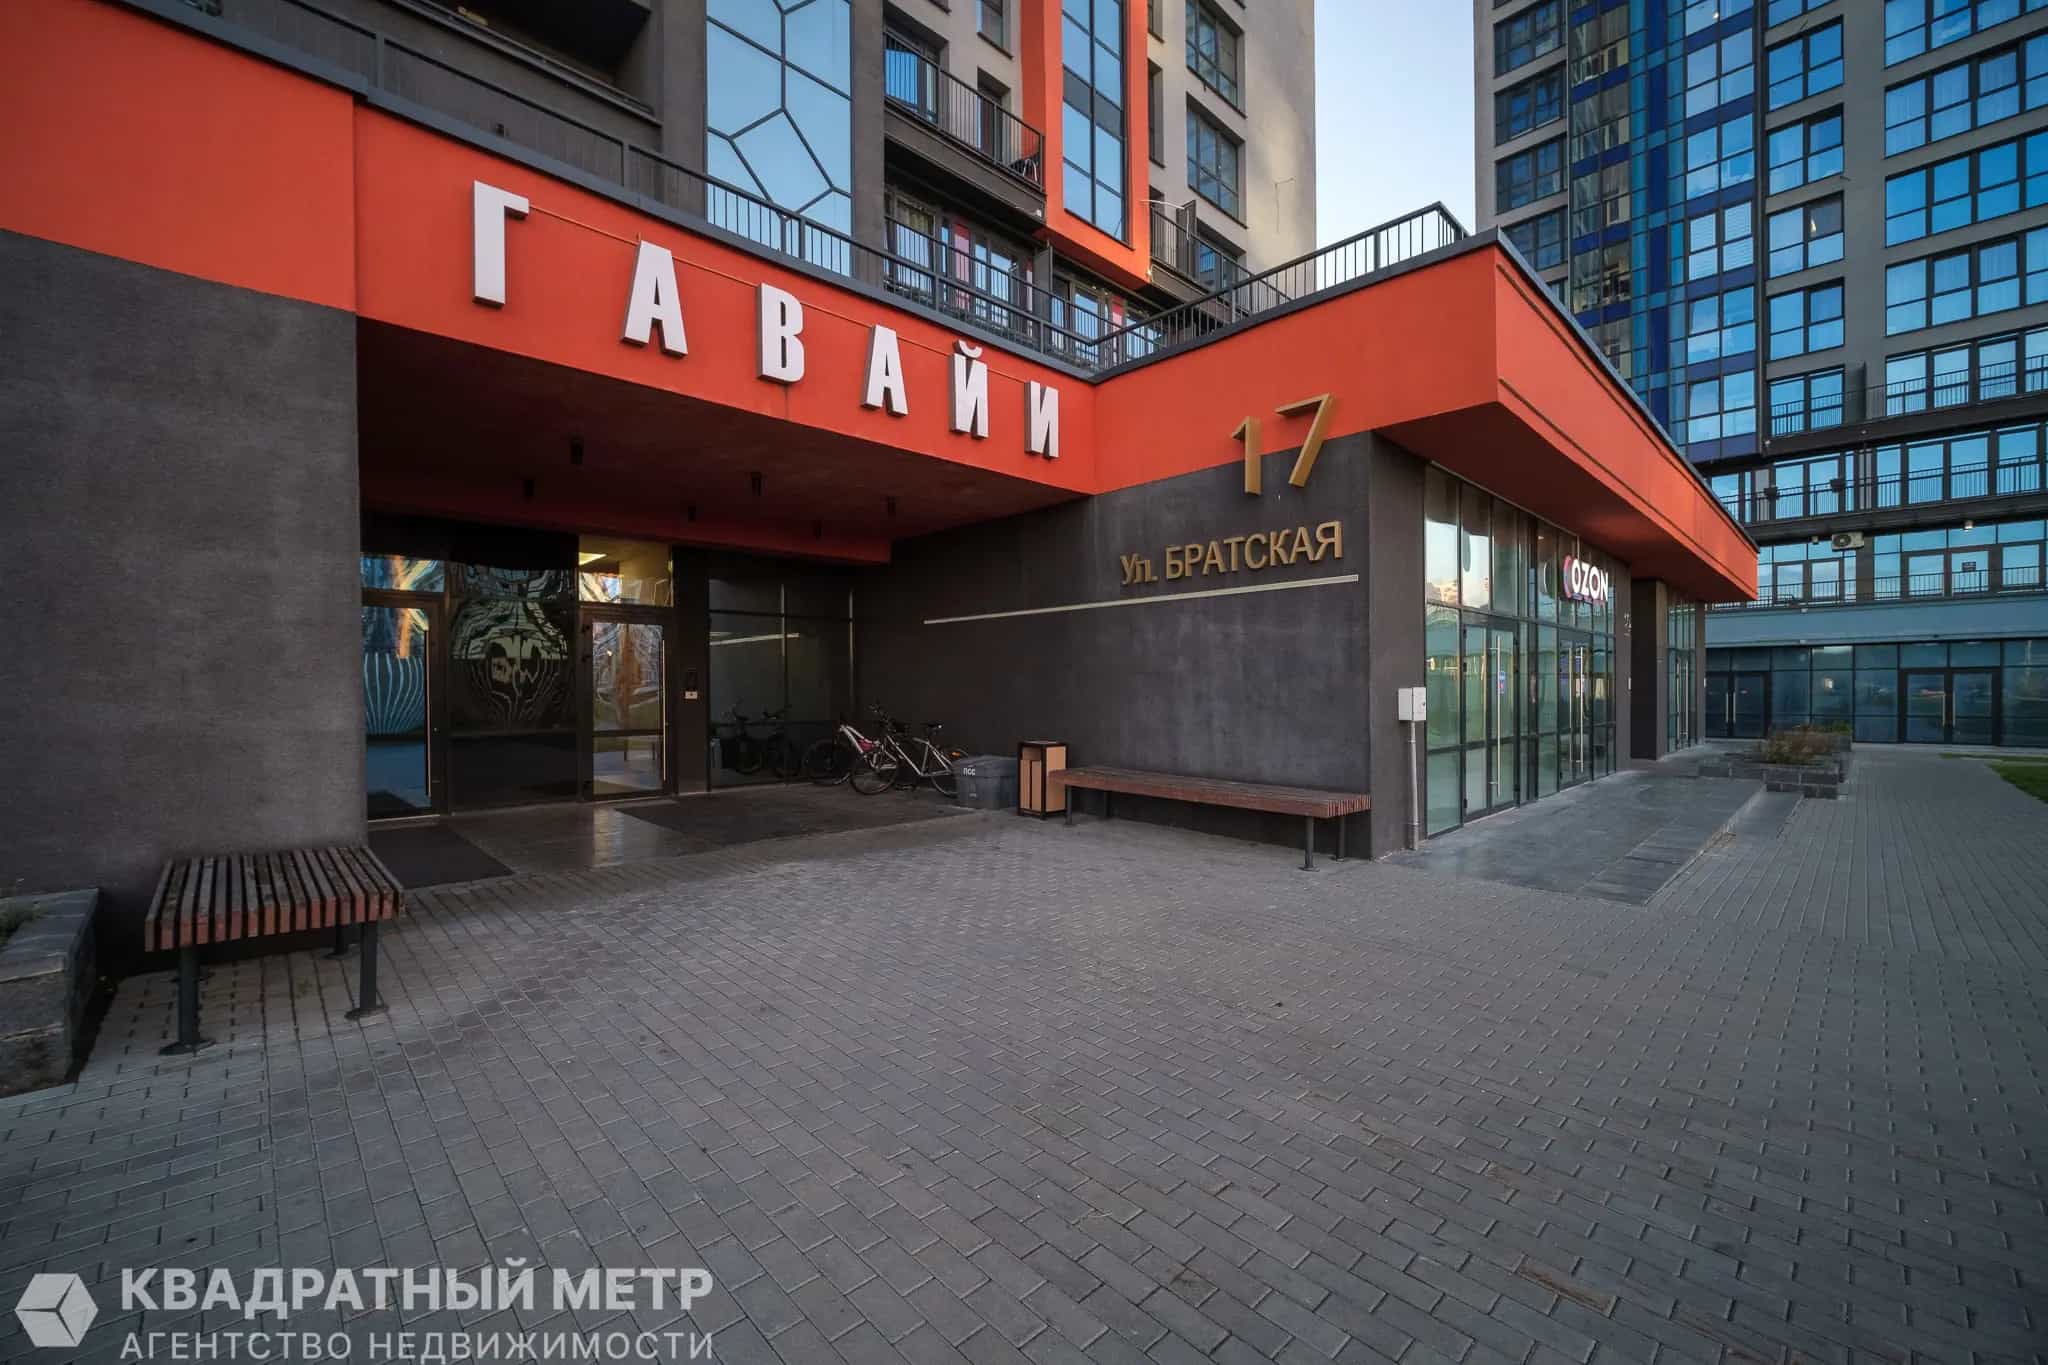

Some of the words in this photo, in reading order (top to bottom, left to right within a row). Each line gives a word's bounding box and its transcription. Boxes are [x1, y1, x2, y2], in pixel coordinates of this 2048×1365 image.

[473, 180, 1060, 459] ГАВАЙИ
[1232, 393, 1335, 495] 17
[1120, 553, 1159, 585] Ул.
[1165, 520, 1343, 580] БРАТСКАЯ
[1572, 558, 1608, 602] OZON
